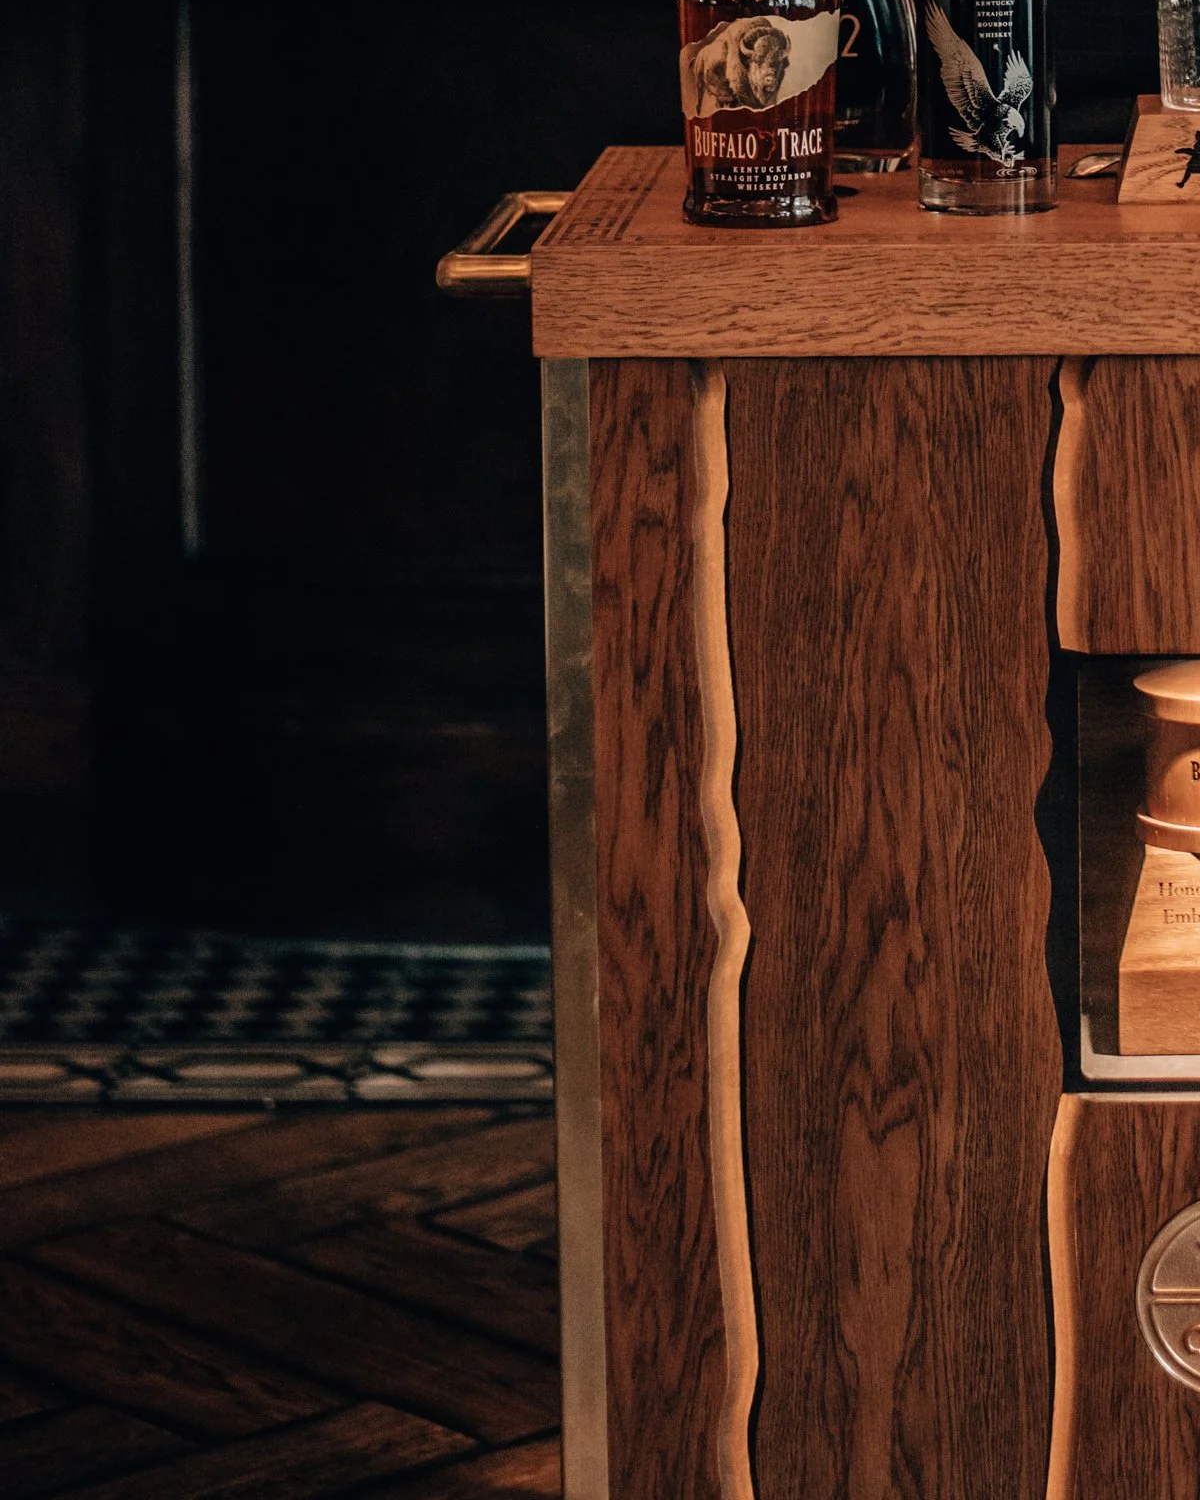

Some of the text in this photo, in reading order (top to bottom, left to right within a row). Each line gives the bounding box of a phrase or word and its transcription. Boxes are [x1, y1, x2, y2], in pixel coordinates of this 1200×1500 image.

[694, 125, 823, 161] BUFFALO TRACE
[733, 165, 788, 174] KENTUCKY
[710, 171, 811, 182] STRAIGHT BOURBON
[737, 182, 785, 192] WHISKEY
